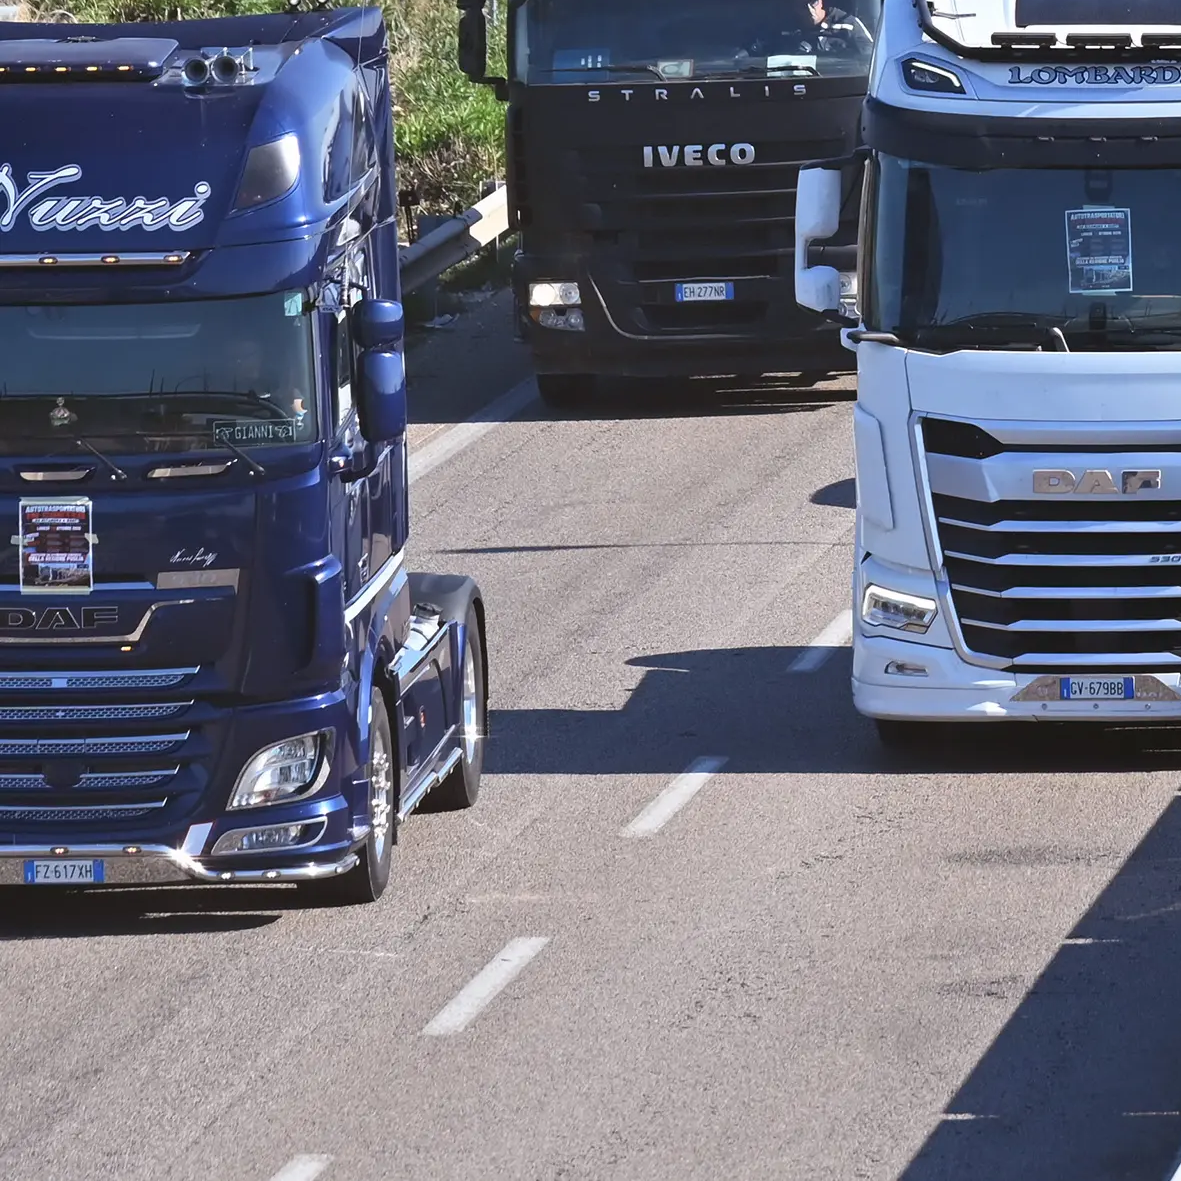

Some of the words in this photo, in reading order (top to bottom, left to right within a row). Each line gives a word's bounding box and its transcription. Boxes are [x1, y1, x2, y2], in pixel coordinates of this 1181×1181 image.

[587, 83, 807, 103] STRALIS
[642, 142, 756, 168] IVECO
[683, 286, 695, 298] EH
[697, 285, 725, 298] 277NR
[234, 424, 274, 440] GIANNI
[1032, 468, 1162, 495] DAF
[1149, 555, 1181, 564] 530
[0, 606, 119, 630] DAF
